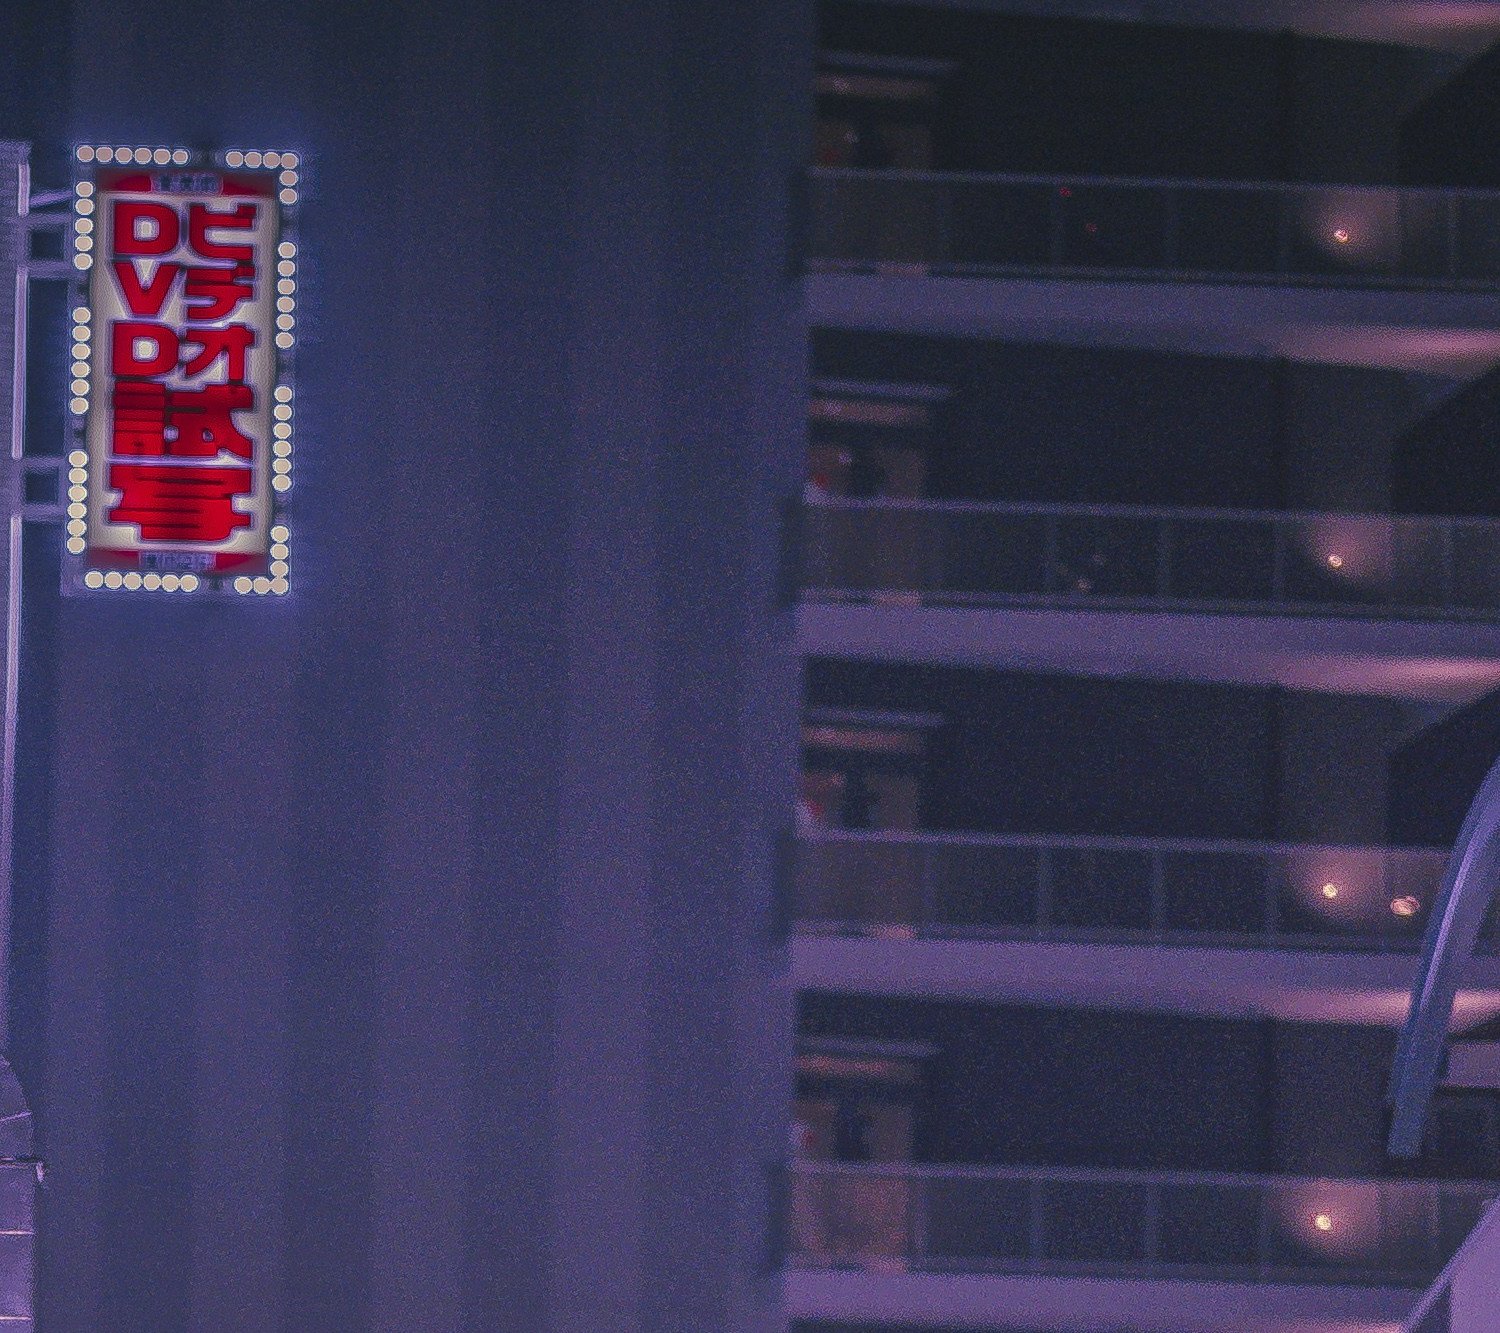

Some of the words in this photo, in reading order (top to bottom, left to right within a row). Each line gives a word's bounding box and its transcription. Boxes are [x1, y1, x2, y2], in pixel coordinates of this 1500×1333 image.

[112, 203, 180, 377] DVD
[184, 204, 257, 382] ビデオ
